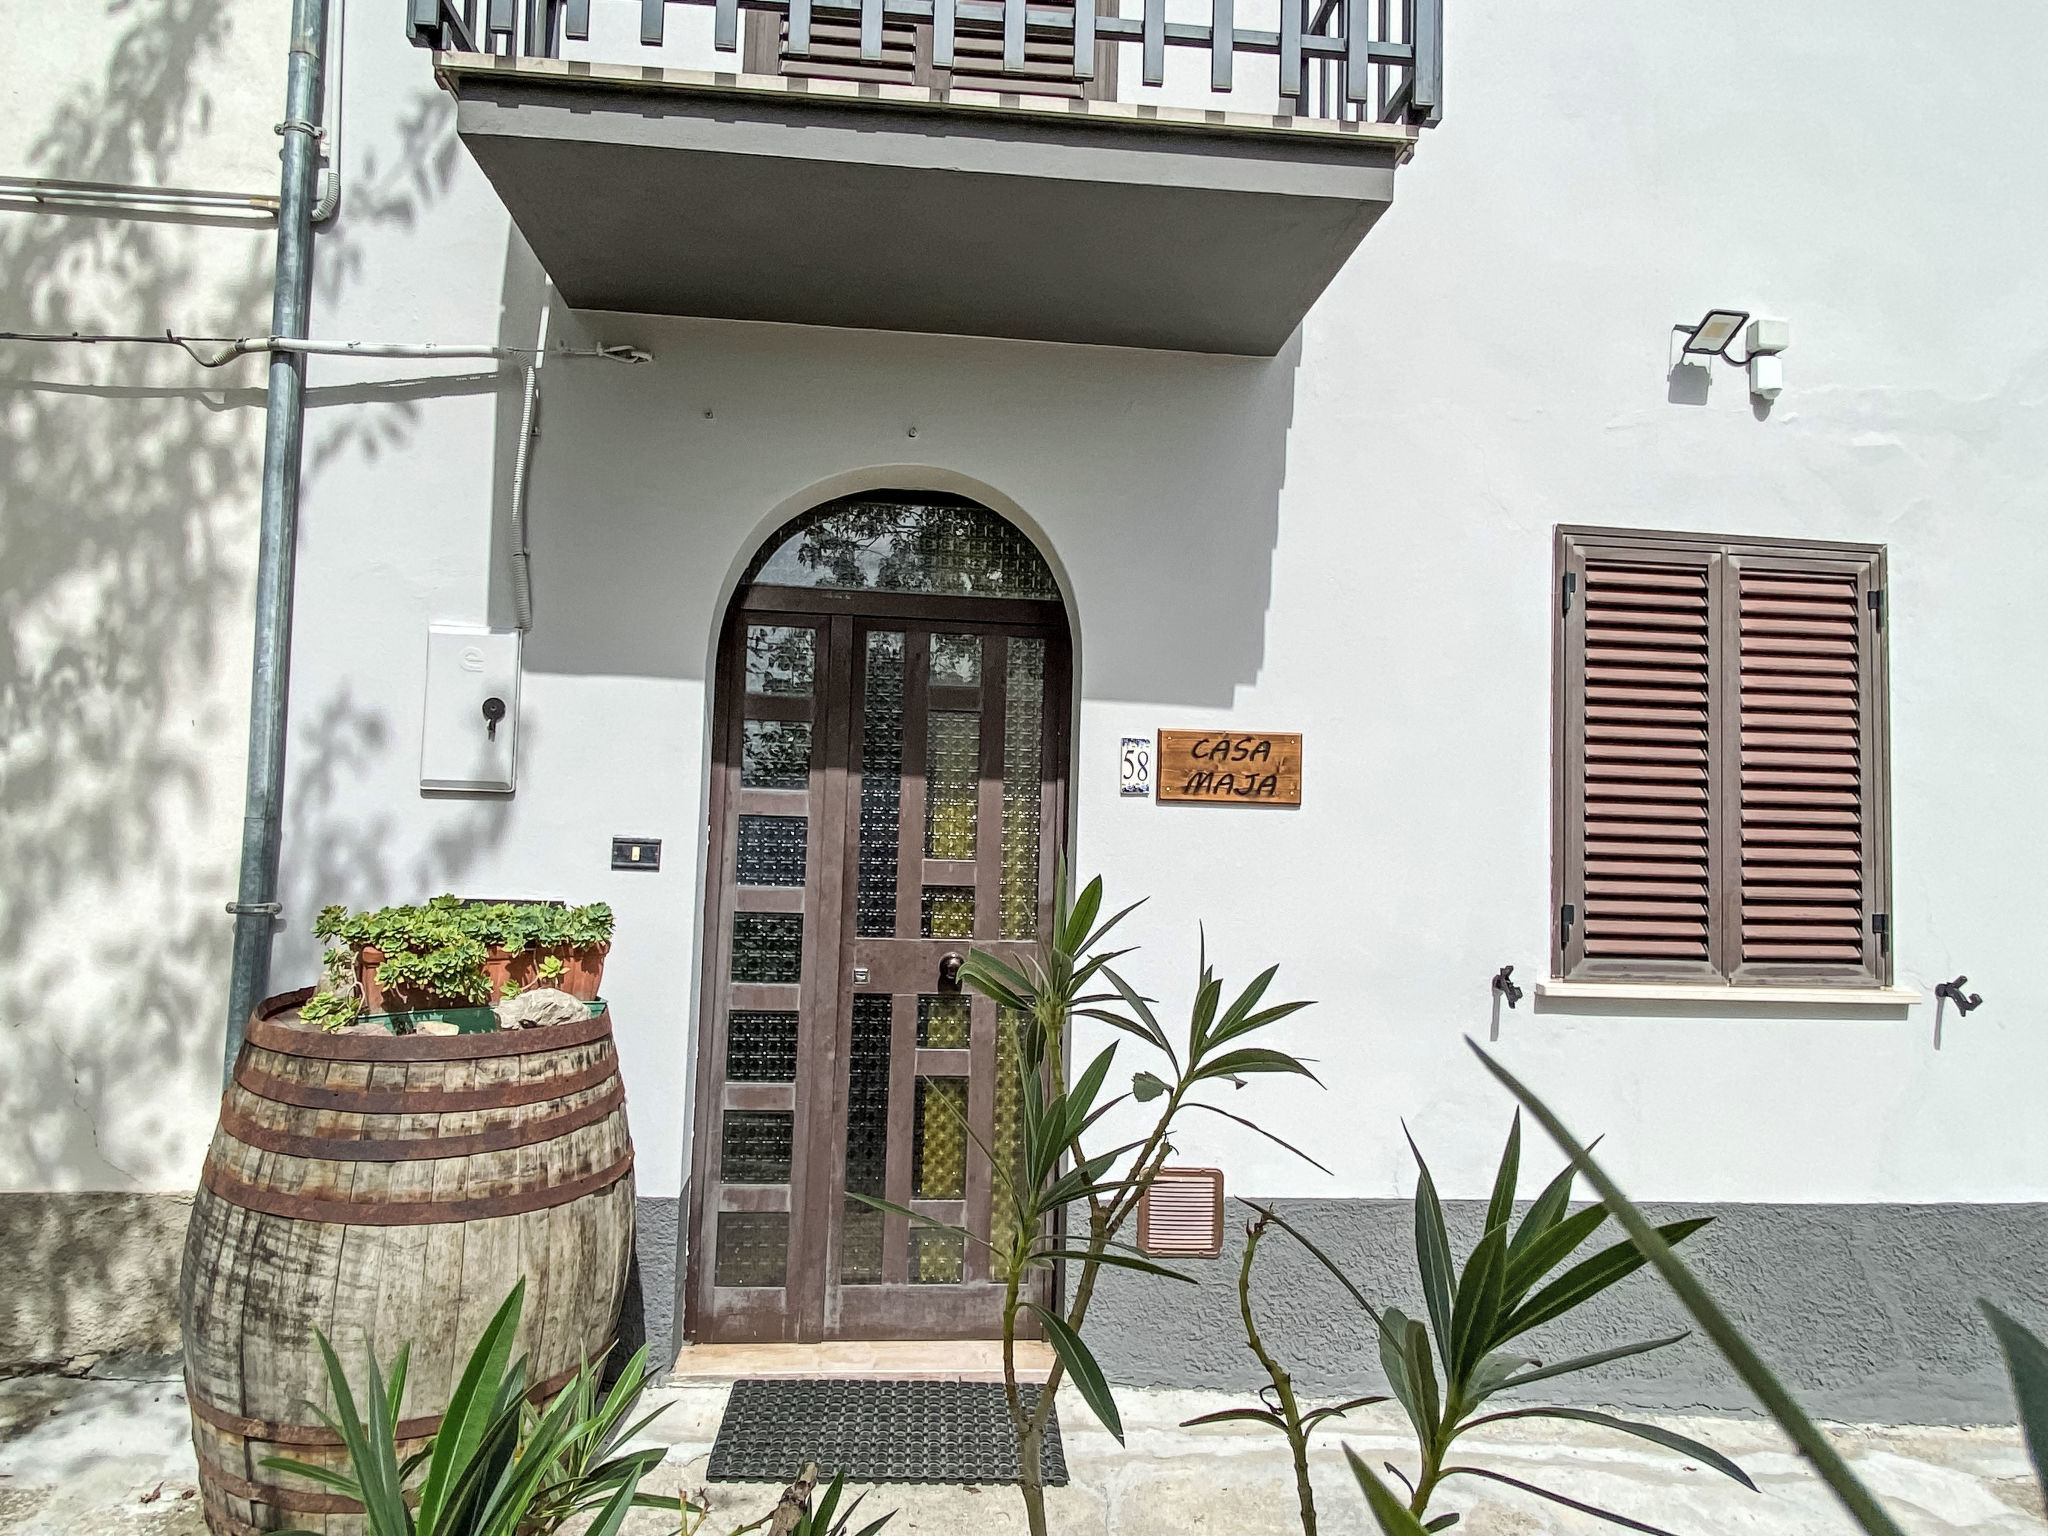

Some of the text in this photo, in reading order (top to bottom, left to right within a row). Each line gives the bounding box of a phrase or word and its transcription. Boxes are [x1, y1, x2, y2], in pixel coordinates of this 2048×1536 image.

[1191, 737, 1272, 762] CASA
[1123, 750, 1149, 781] 58
[1183, 772, 1278, 797] MAJA
